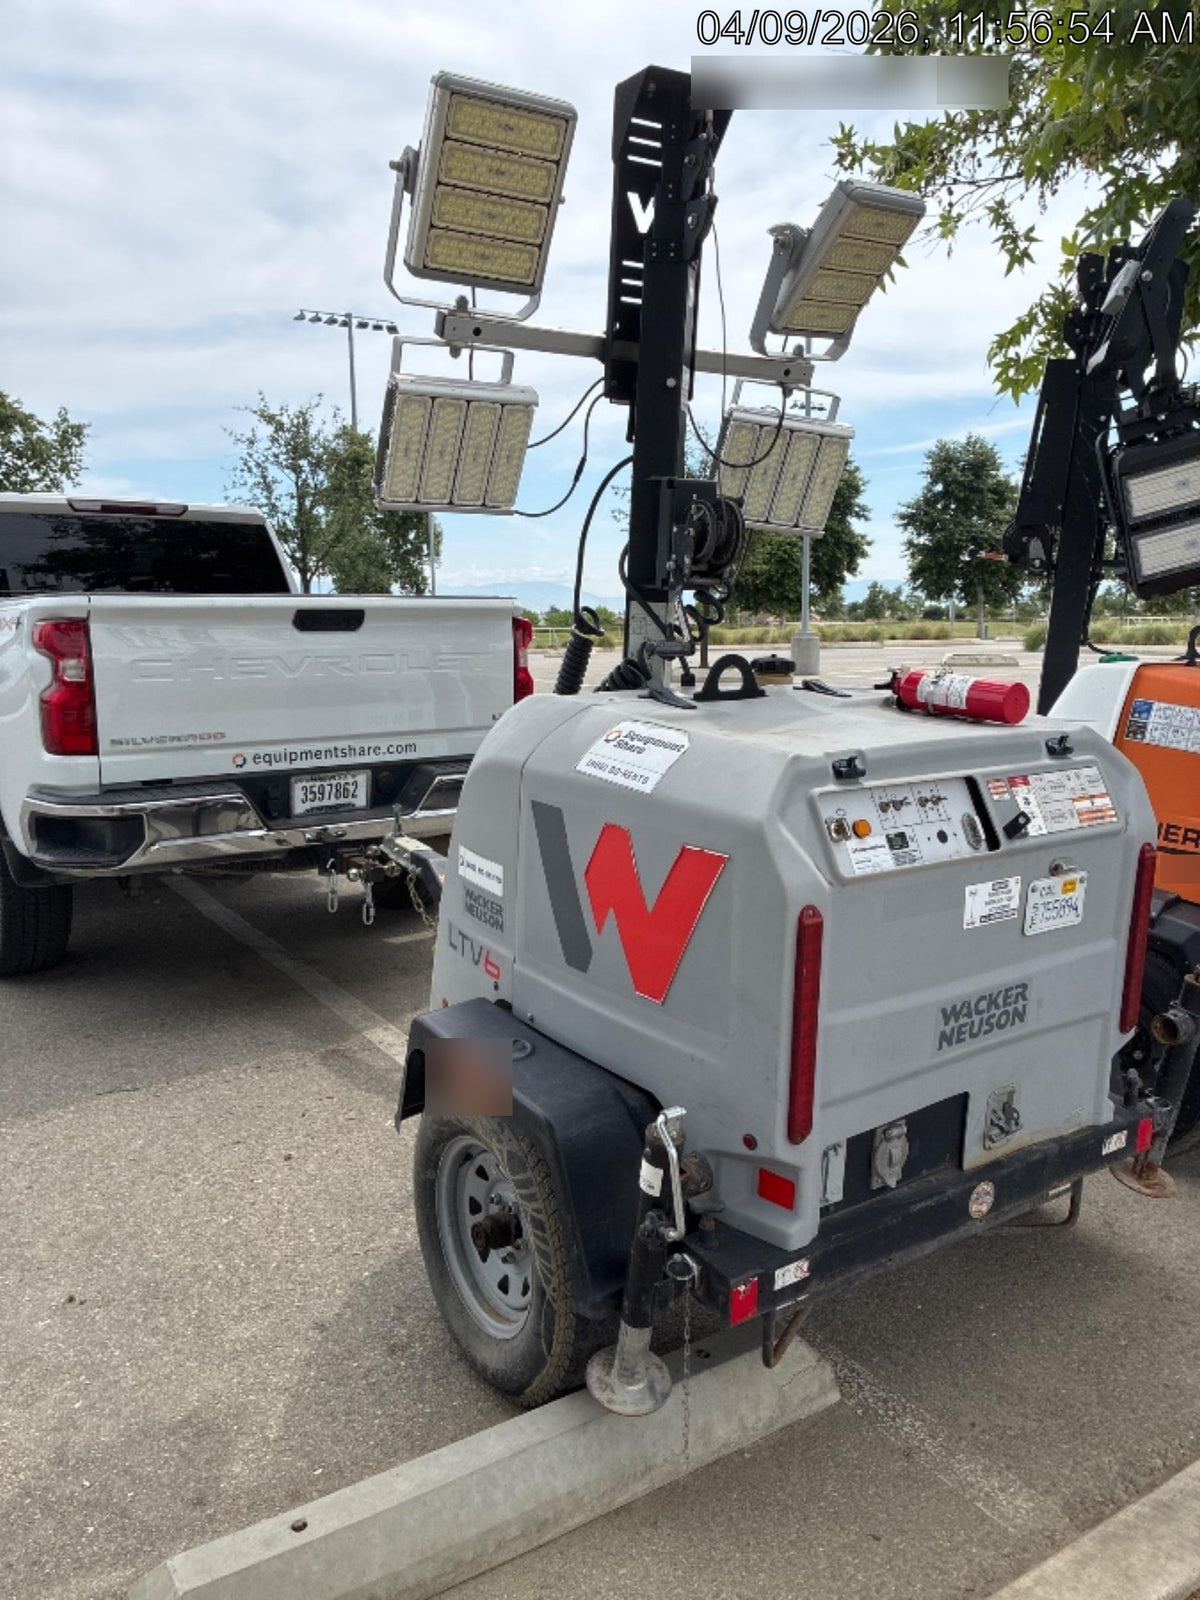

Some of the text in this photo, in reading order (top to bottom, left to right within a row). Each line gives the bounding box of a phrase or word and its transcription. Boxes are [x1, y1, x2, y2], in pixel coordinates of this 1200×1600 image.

[131, 650, 490, 683] CHEVROLET
[109, 731, 226, 746] SILVERADO
[252, 742, 417, 766] equipmentshare.com
[301, 780, 358, 804] 3597862
[941, 982, 1029, 1027] WACKER
[936, 1003, 1028, 1052] NEUSON
